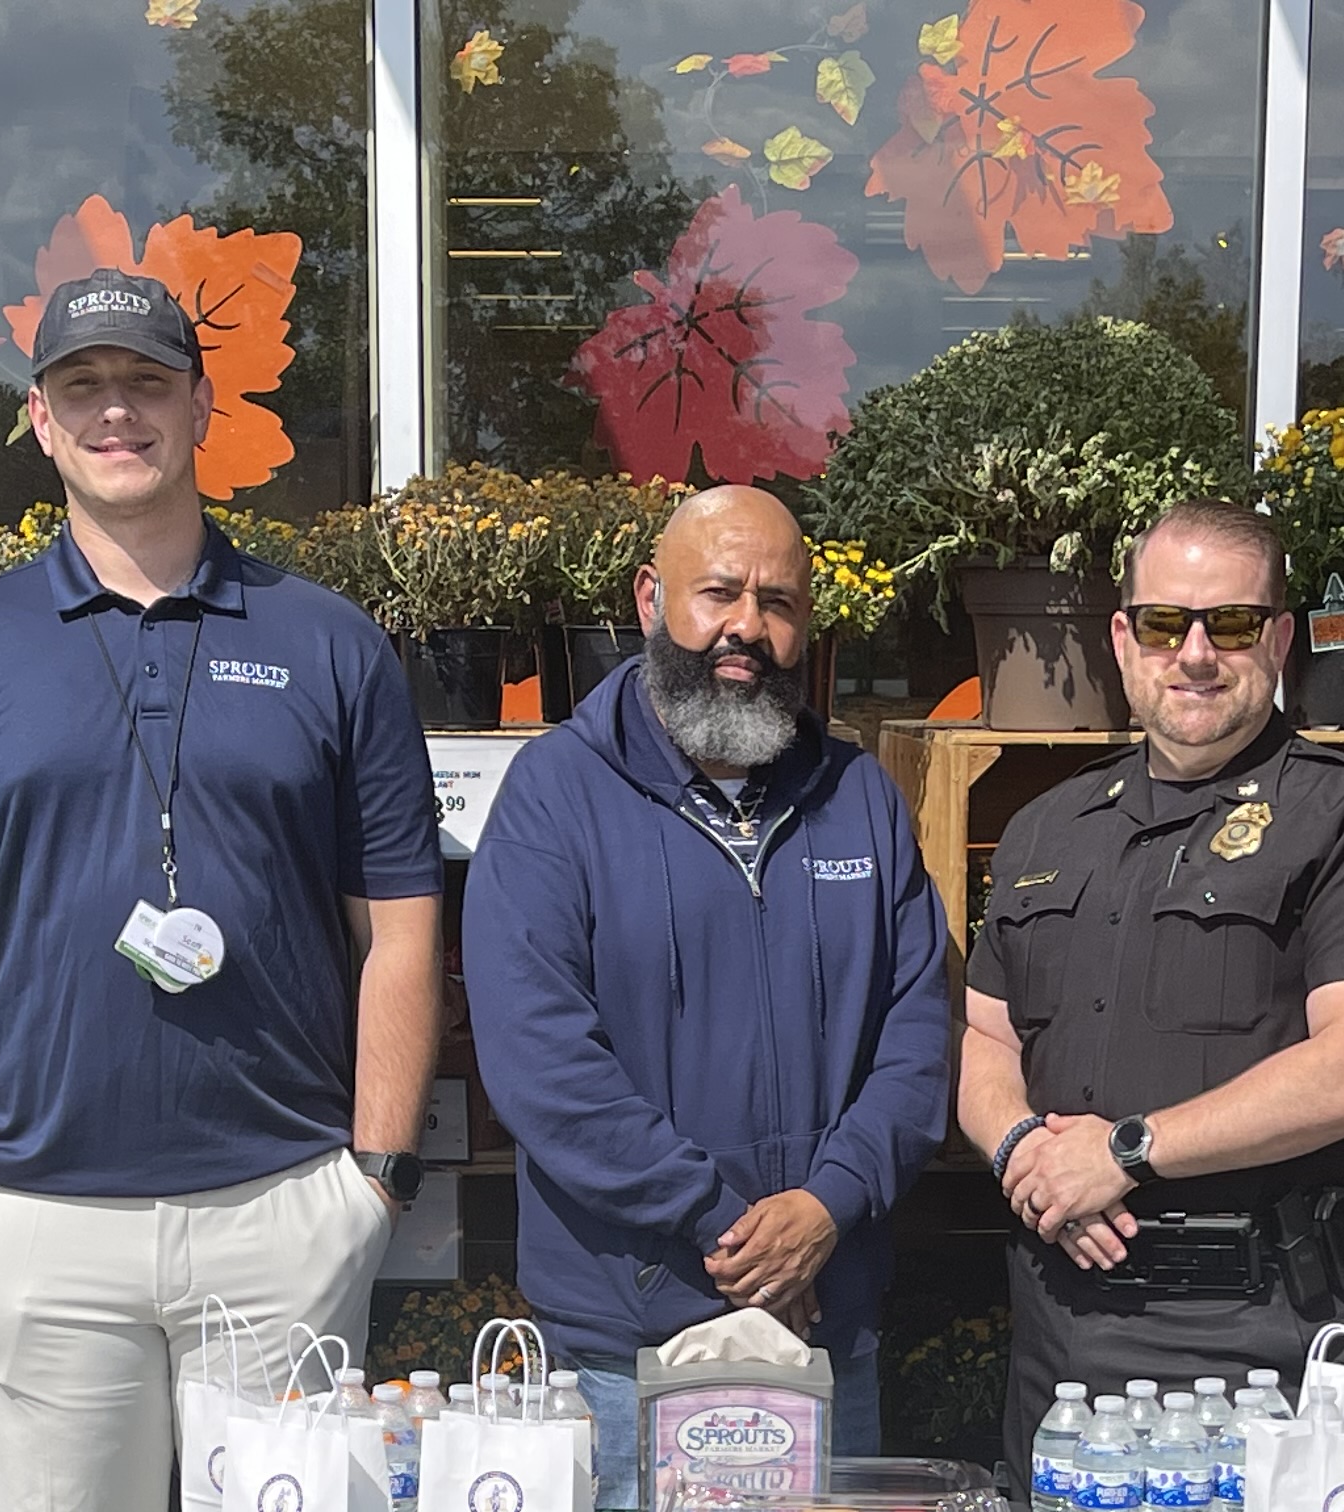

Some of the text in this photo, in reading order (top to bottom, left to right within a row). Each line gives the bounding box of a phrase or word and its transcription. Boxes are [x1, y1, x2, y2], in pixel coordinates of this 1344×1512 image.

[67, 289, 152, 314] SPROUTS
[208, 659, 290, 684] SPROUTS
[685, 1426, 786, 1451] SPROUTS
